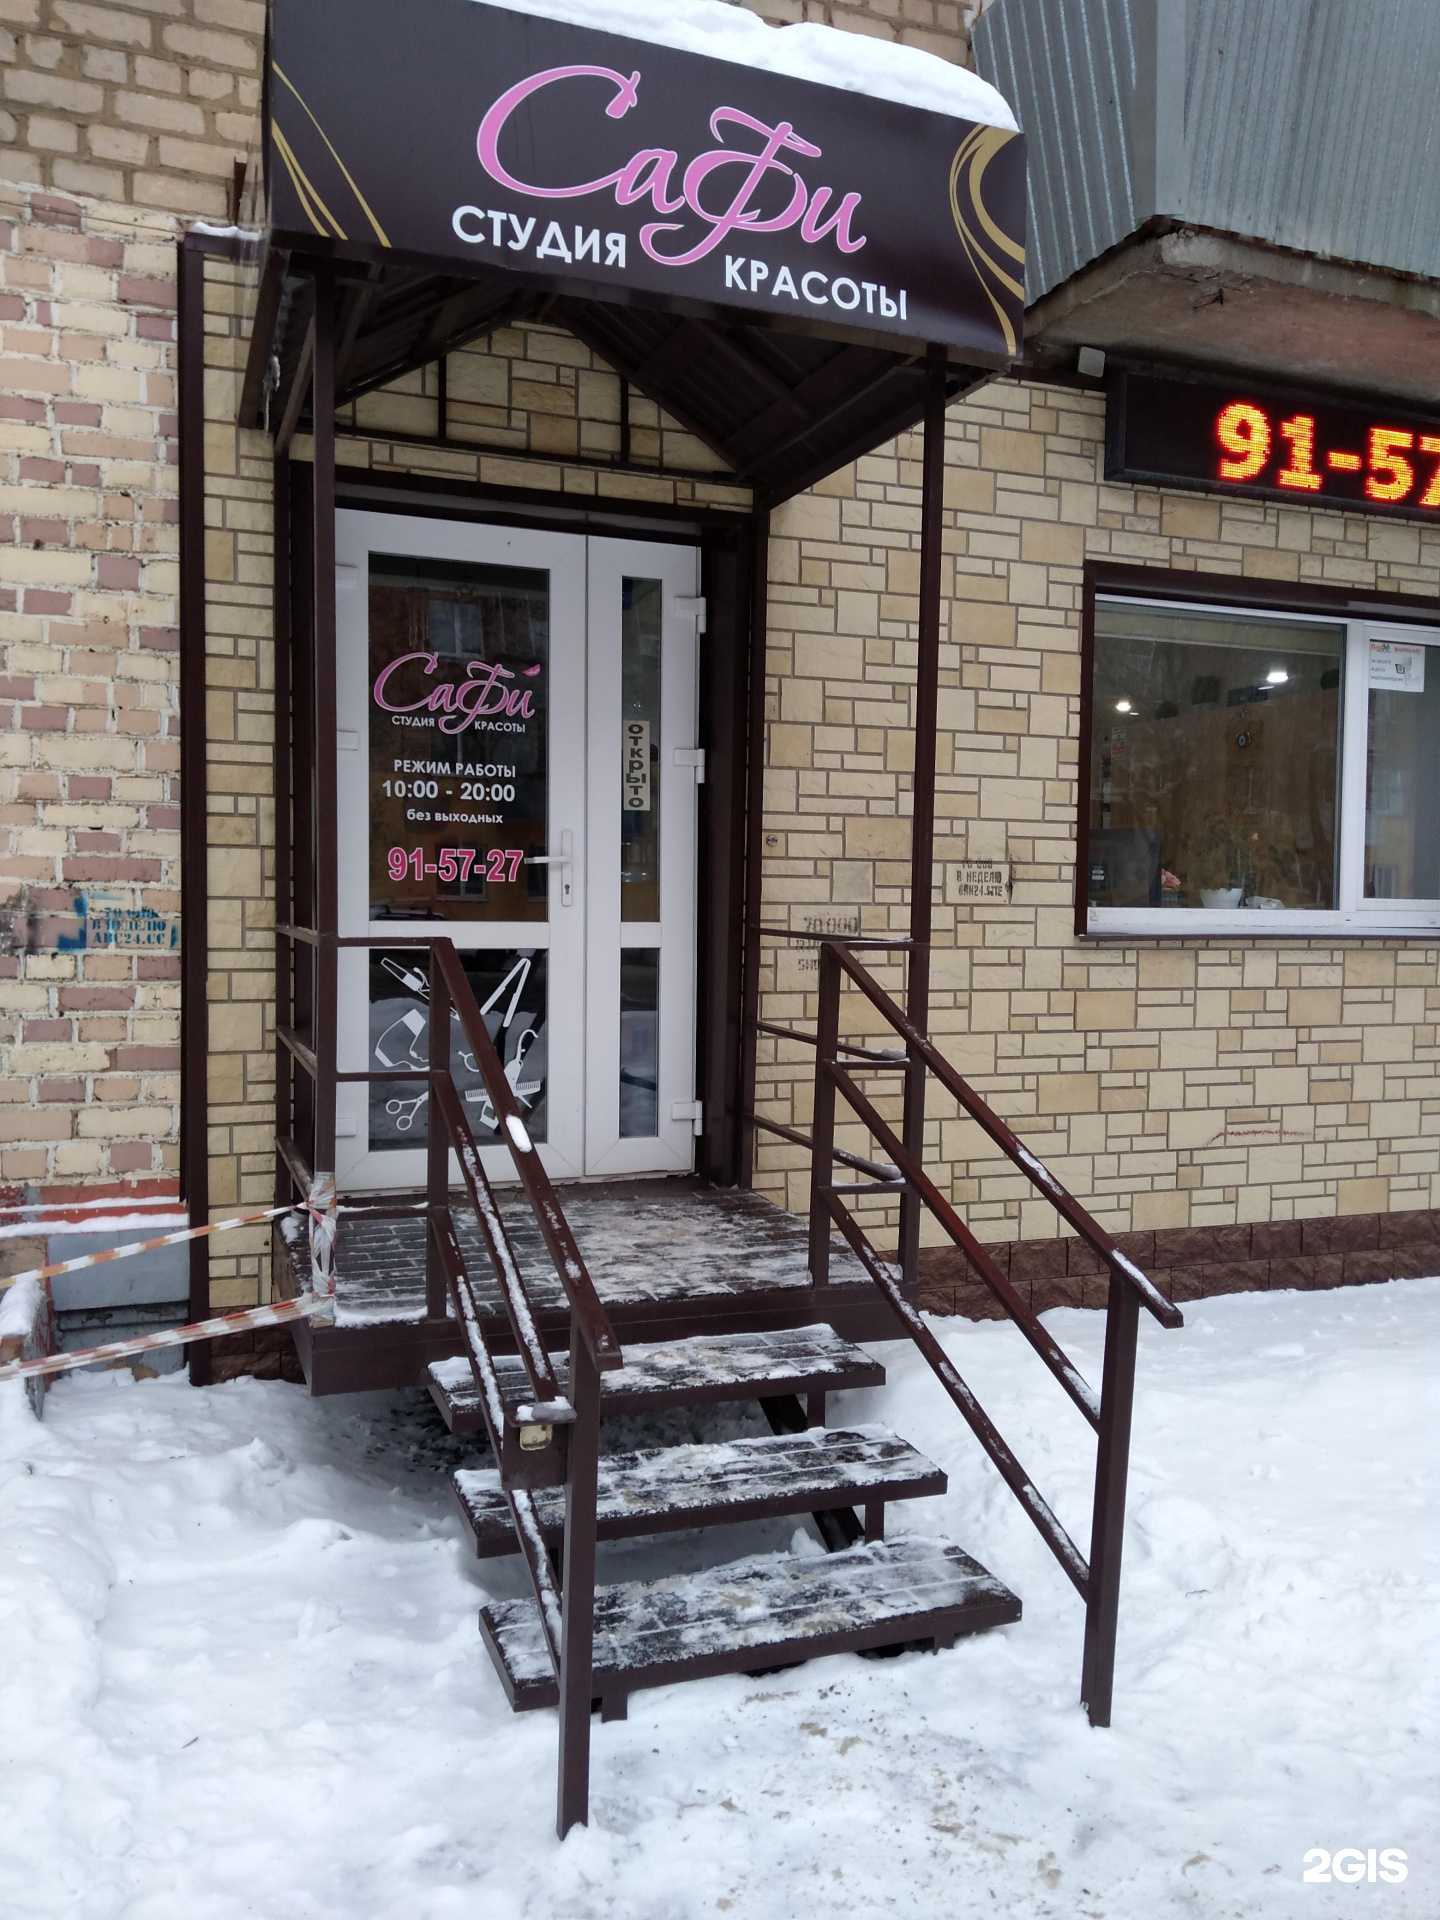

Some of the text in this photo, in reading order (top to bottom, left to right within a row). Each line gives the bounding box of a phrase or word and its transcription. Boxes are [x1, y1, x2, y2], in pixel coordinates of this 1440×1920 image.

[451, 204, 907, 320] СТУДИЯ КРАСОТЫ
[391, 715, 526, 733] СТУДИЯ КРАСОТЫ
[393, 759, 516, 778] РЕЖИМ РАБОТЫ
[382, 780, 439, 798] 10:00
[460, 782, 516, 802] 20:00
[406, 808, 504, 824] без выходных
[387, 847, 524, 882] 91-57-27
